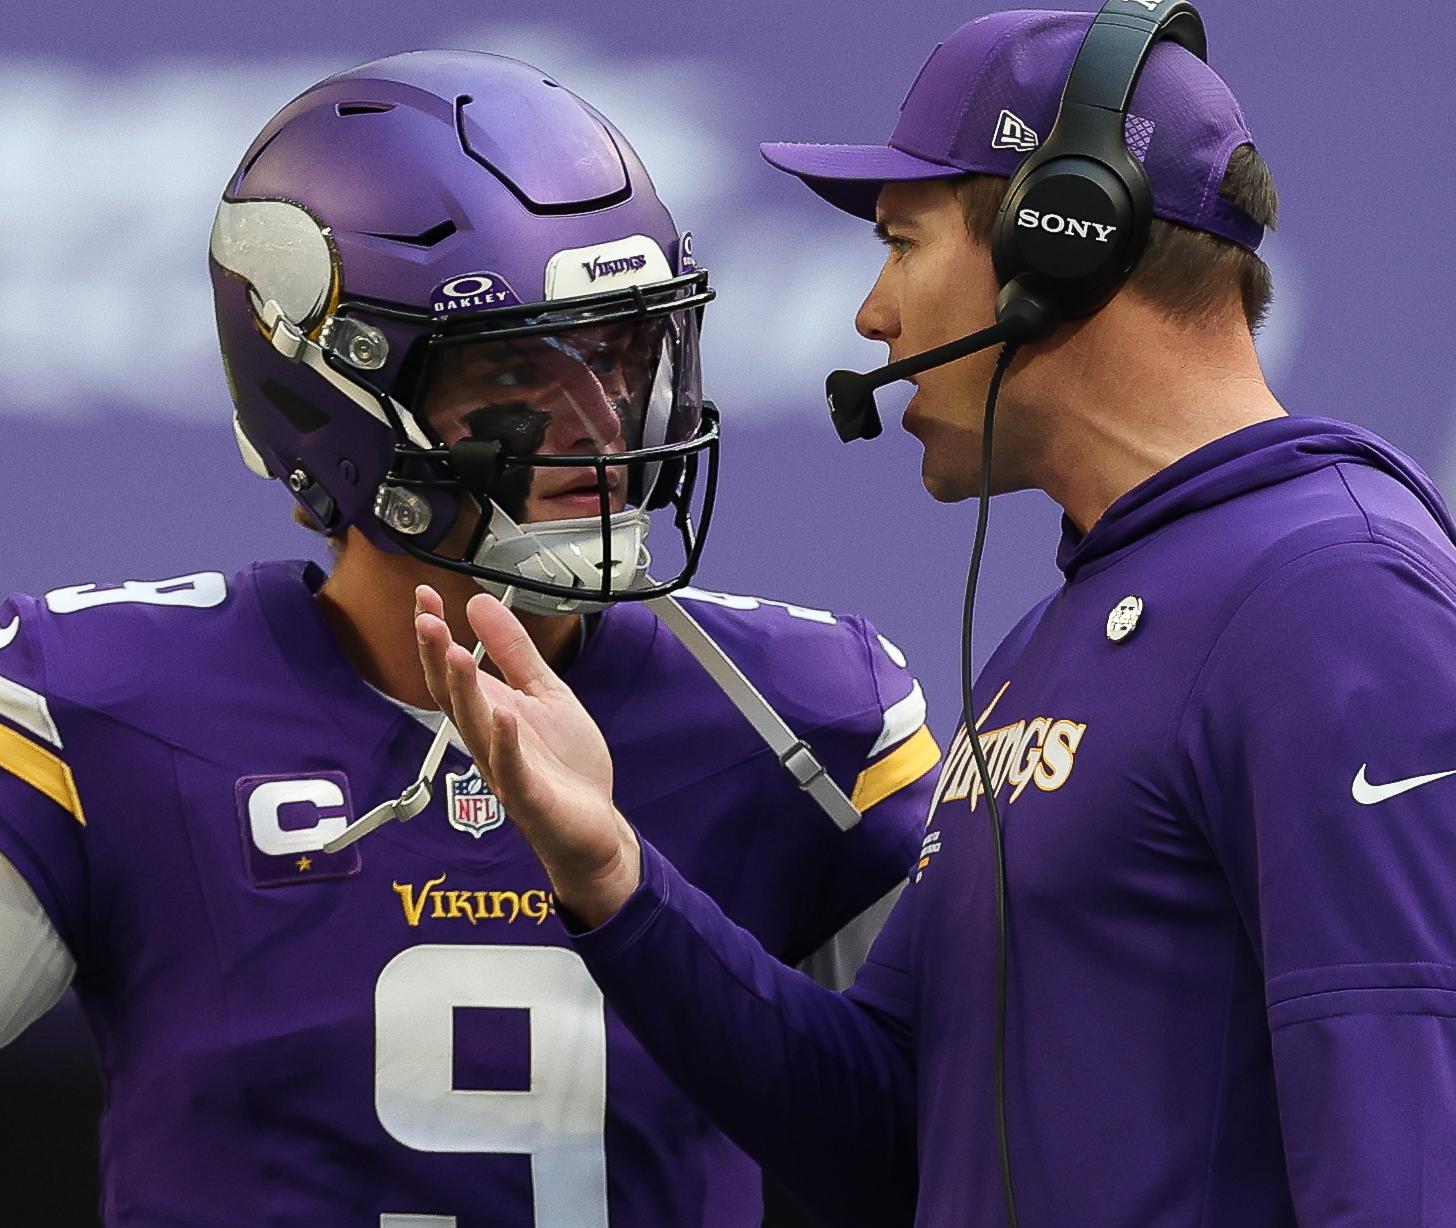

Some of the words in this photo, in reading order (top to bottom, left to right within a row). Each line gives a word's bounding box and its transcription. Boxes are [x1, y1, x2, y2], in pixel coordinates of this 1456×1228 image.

[1018, 208, 1117, 242] SONY
[434, 290, 507, 312] OAKLEY
[248, 778, 347, 856] C
[457, 797, 496, 824] NFL
